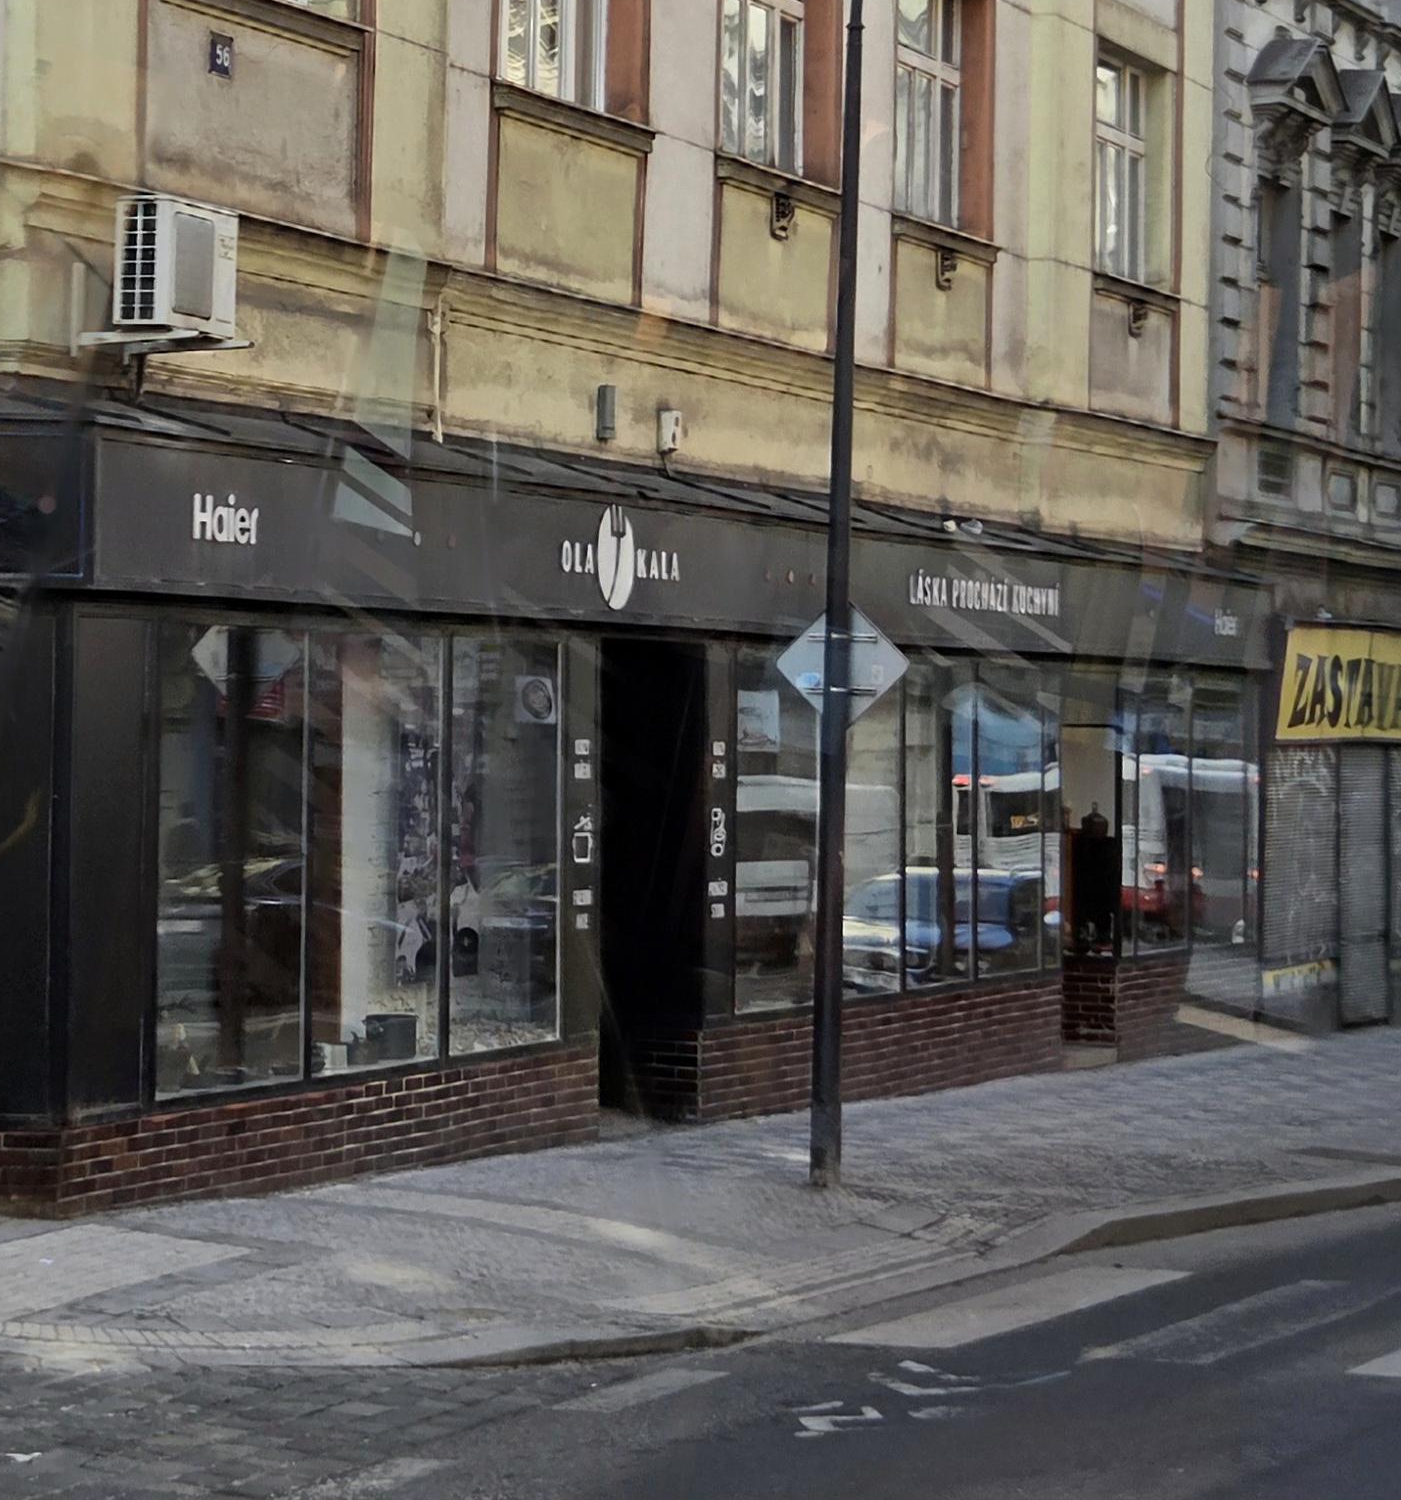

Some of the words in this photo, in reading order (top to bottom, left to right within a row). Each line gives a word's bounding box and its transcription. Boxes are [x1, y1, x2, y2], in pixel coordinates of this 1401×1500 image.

[216, 44, 230, 67] 56
[192, 493, 259, 545] Haier
[561, 540, 594, 575] OLA
[637, 548, 680, 582] KALA
[909, 568, 948, 606] LÁSKA
[951, 576, 1008, 612] PROCHÁZÍ
[1011, 582, 1060, 616] KUCHYNÍ
[1287, 653, 1401, 731] ZASTAV
